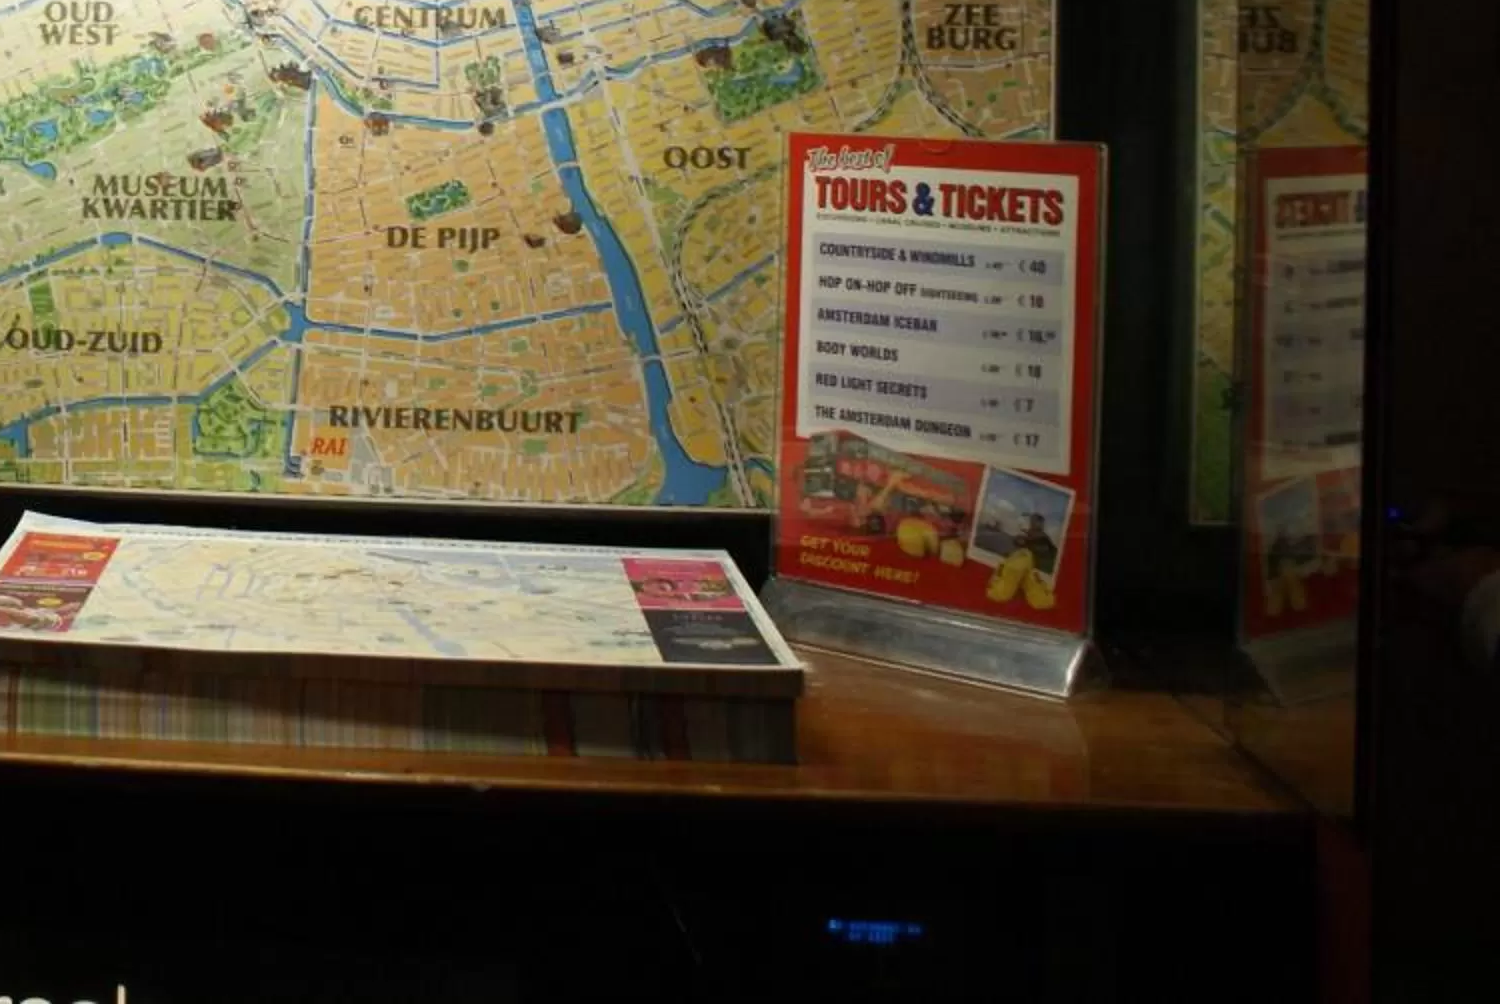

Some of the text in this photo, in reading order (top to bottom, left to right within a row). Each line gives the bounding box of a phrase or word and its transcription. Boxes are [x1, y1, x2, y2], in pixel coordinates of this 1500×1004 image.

[44, 0, 113, 23] OUD
[354, 6, 506, 29] CENTRUM
[945, 3, 1000, 26] ZEE
[39, 24, 118, 46] WEST
[926, 27, 1018, 51] BURG
[664, 146, 751, 169] OOST
[807, 146, 836, 171] The
[873, 143, 896, 173] of
[93, 176, 228, 198] MUSEUM
[81, 198, 236, 221] KWARTIER
[815, 176, 1064, 226] TOURS & TICKETS
[387, 228, 499, 252] DE PIJP
[819, 242, 896, 261] COUNTRYSIDE
[910, 249, 976, 268] WINDMILLS
[819, 276, 842, 289] HOP
[894, 282, 917, 296] OFF
[817, 308, 890, 328] AMSTERDAM
[894, 315, 938, 333] ICEBAR
[4, 327, 162, 354] OUD-ZUID
[816, 340, 847, 357] BODY
[850, 344, 899, 362] WORLDS
[815, 372, 837, 387] RED
[841, 376, 873, 393] LIGHT
[876, 382, 928, 400] SECRETS
[329, 404, 582, 434] RIVIERENBUURT
[815, 404, 835, 420] THE
[839, 409, 911, 431] AMSTERDAM
[915, 419, 972, 438] DUNGEON
[311, 437, 348, 456] RAI
[801, 535, 870, 556] GET YOUR
[800, 553, 871, 575] DISCOUNT
